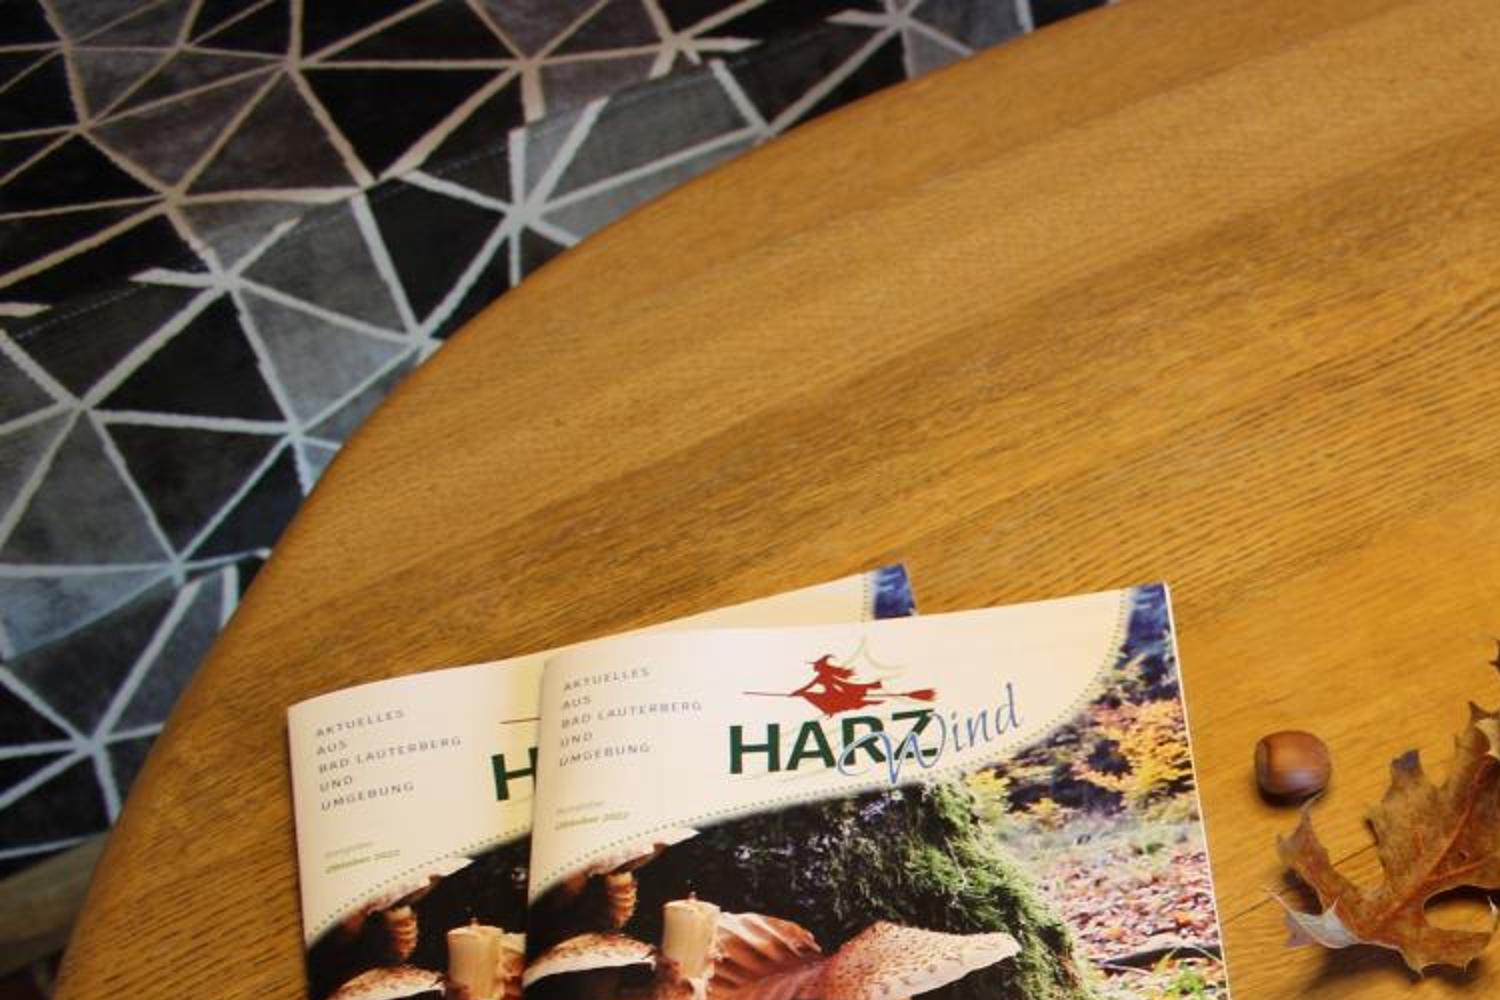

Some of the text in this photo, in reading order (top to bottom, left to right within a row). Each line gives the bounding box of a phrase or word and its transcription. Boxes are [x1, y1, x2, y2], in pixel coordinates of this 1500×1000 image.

[563, 667, 650, 691] AKTUELLES
[561, 701, 702, 729] BAD LAUTERBERG
[562, 695, 592, 710] AUS
[316, 709, 405, 737] AKTUELLES
[729, 682, 1020, 784] HARZ Wind
[316, 740, 348, 756] AUS
[560, 732, 592, 747] UND
[318, 736, 462, 774] BAD LAUTERBERG
[559, 742, 650, 767] UMGEBUNG
[320, 775, 353, 792] UND
[321, 781, 414, 811] UMGEBUNG
